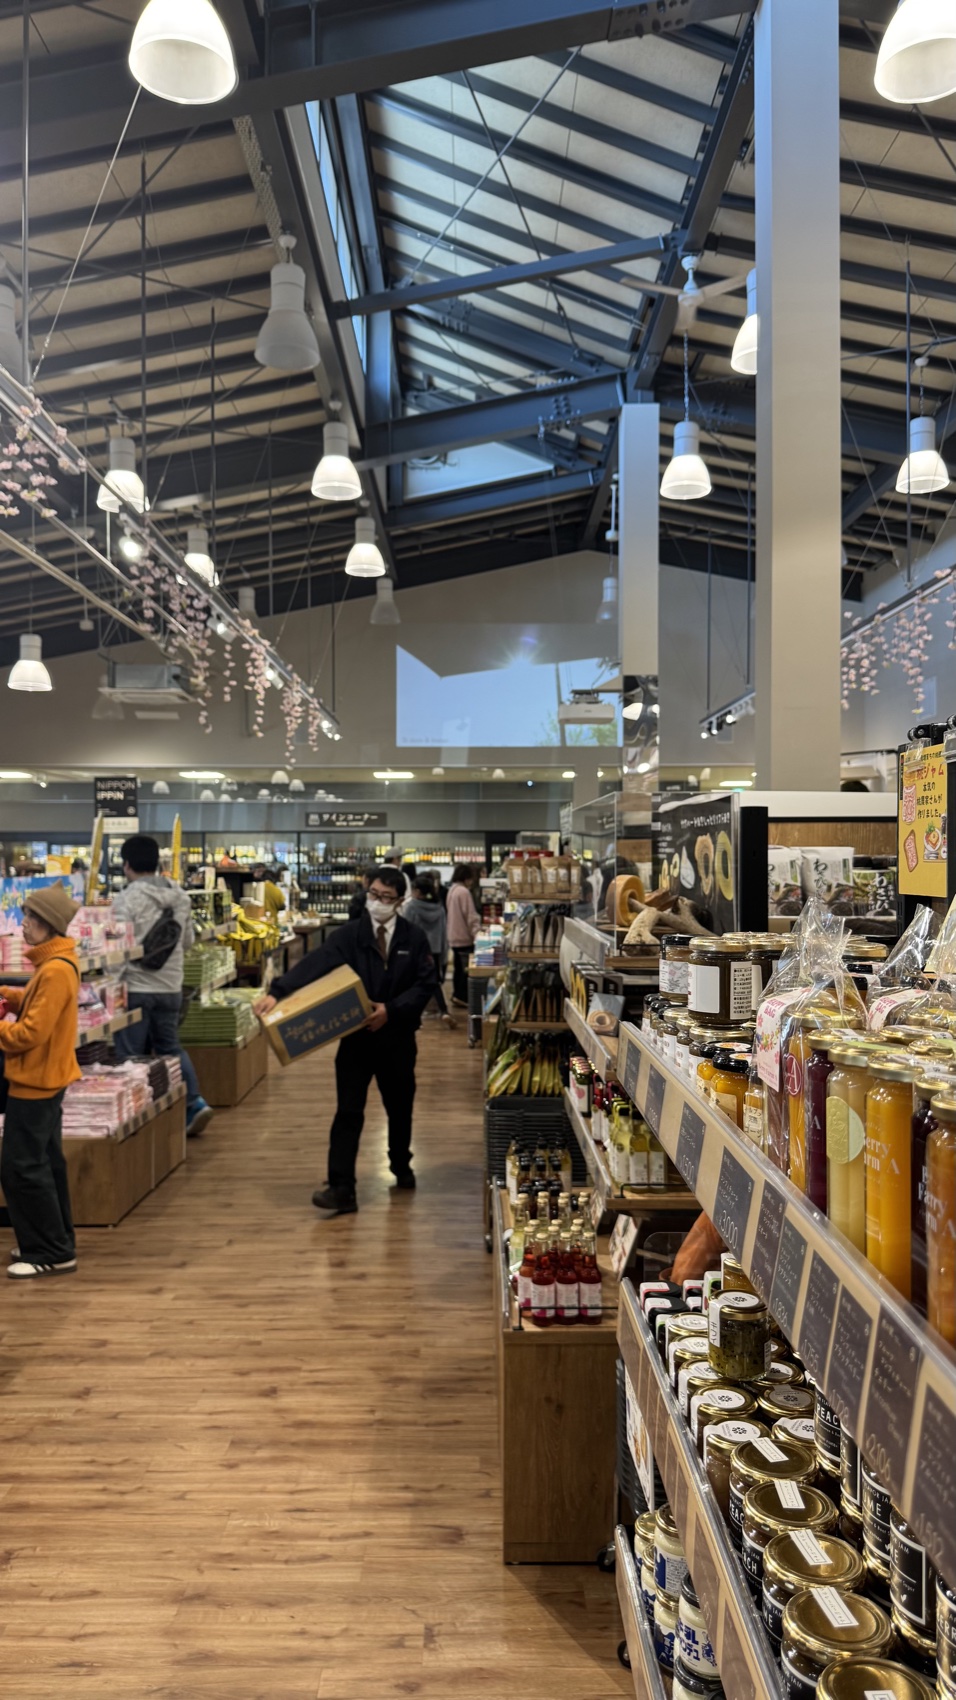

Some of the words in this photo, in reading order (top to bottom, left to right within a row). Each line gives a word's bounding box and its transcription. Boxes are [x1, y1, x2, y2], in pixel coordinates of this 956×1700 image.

[322, 812, 378, 822] ワインコーナー
[872, 872, 889, 911] わさび
[816, 1402, 838, 1426] PEAC
